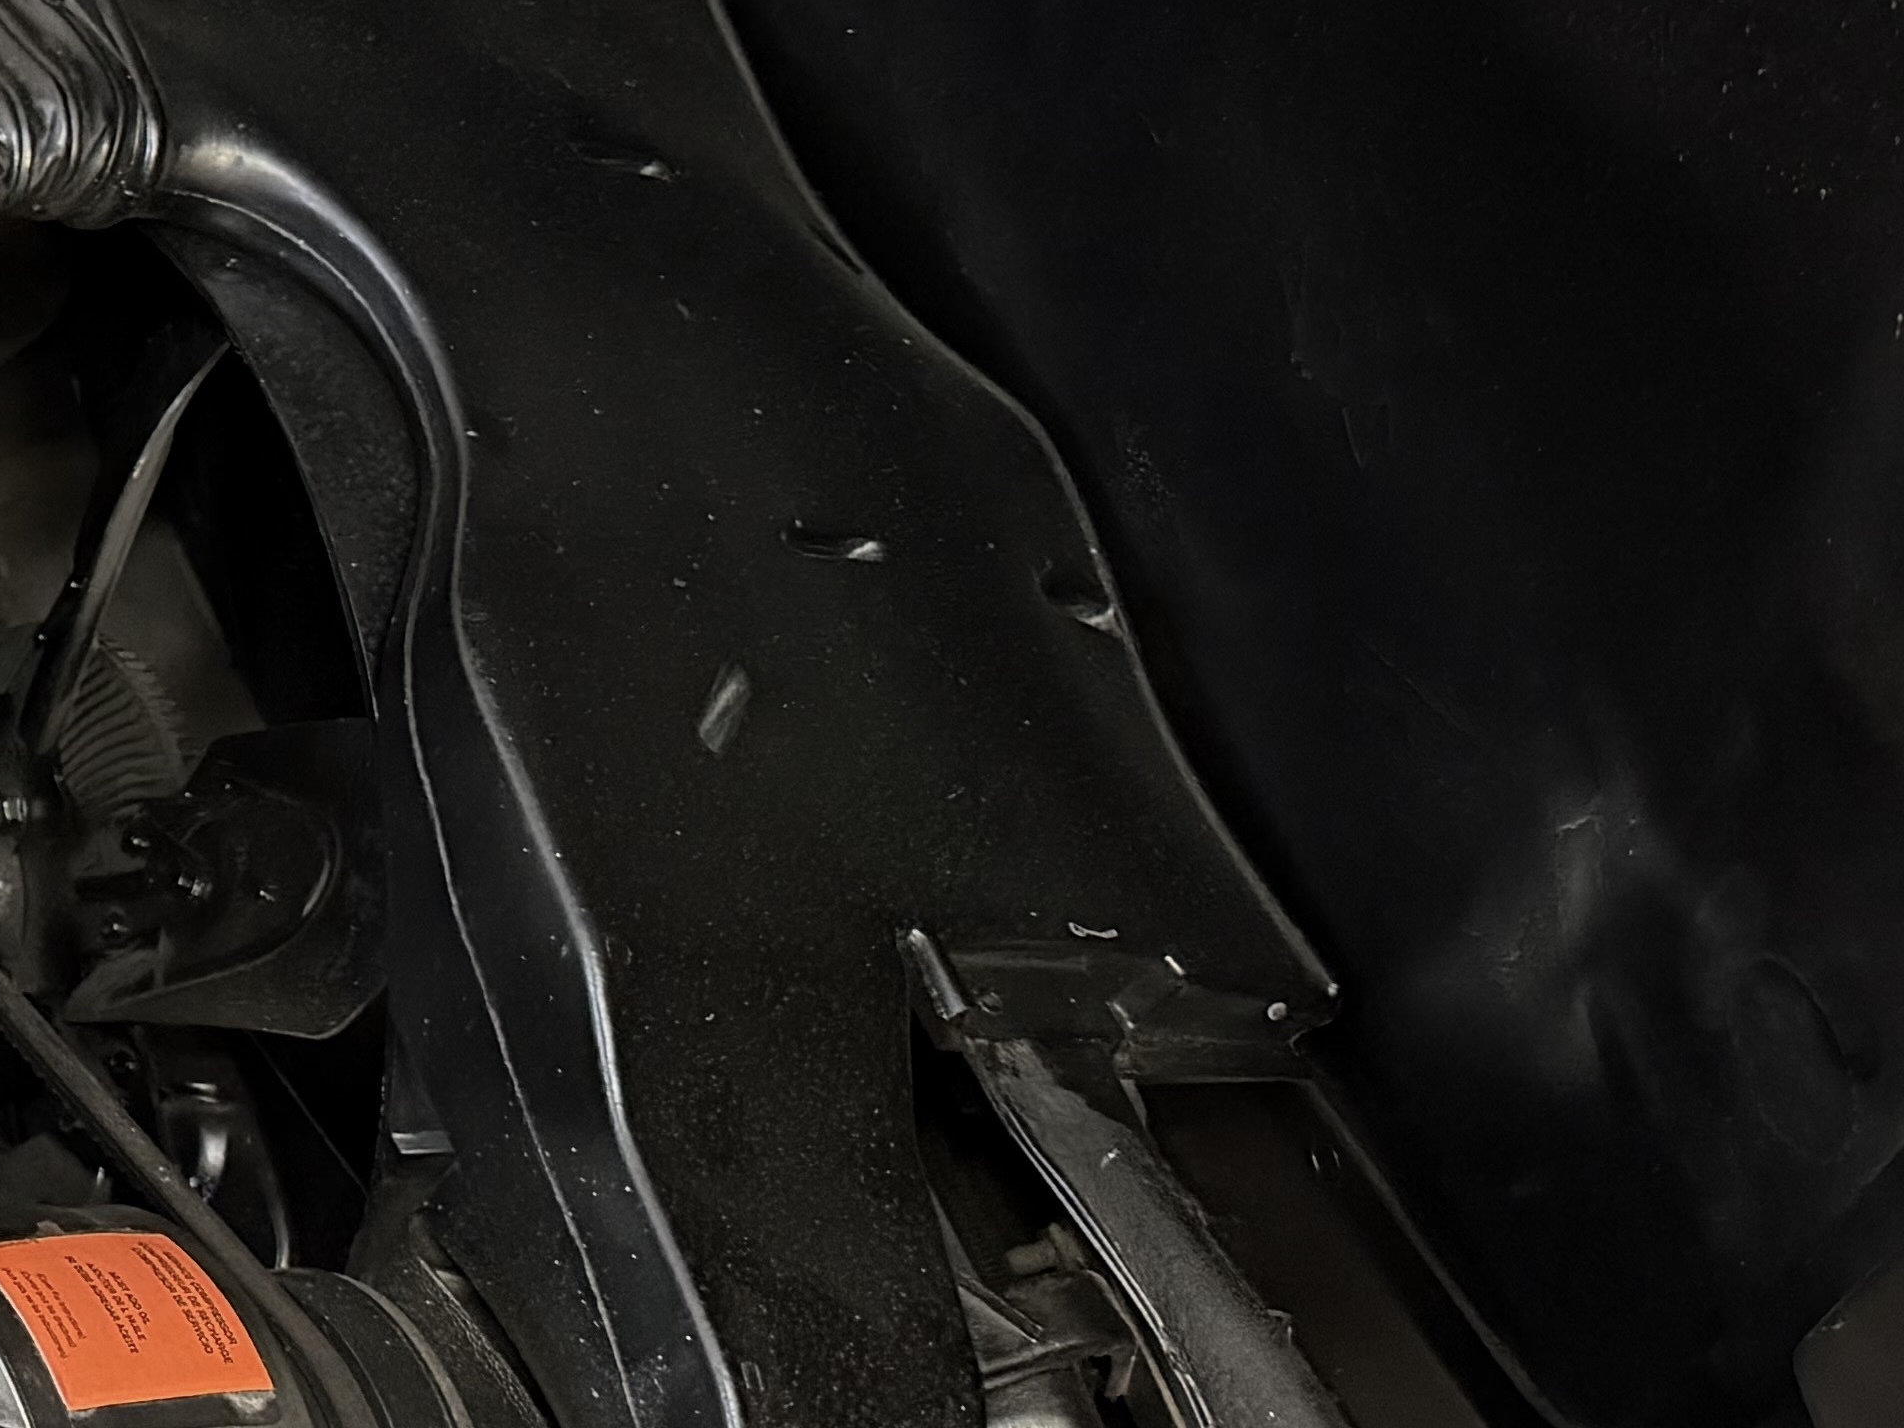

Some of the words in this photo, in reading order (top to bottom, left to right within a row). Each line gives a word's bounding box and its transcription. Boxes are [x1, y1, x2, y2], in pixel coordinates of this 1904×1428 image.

[125, 1294, 143, 1309] ADD
[190, 1281, 238, 1345] COMPRESSOR
[182, 1307, 215, 1354] SERVICIO
[196, 1309, 234, 1364] RECHARGE
